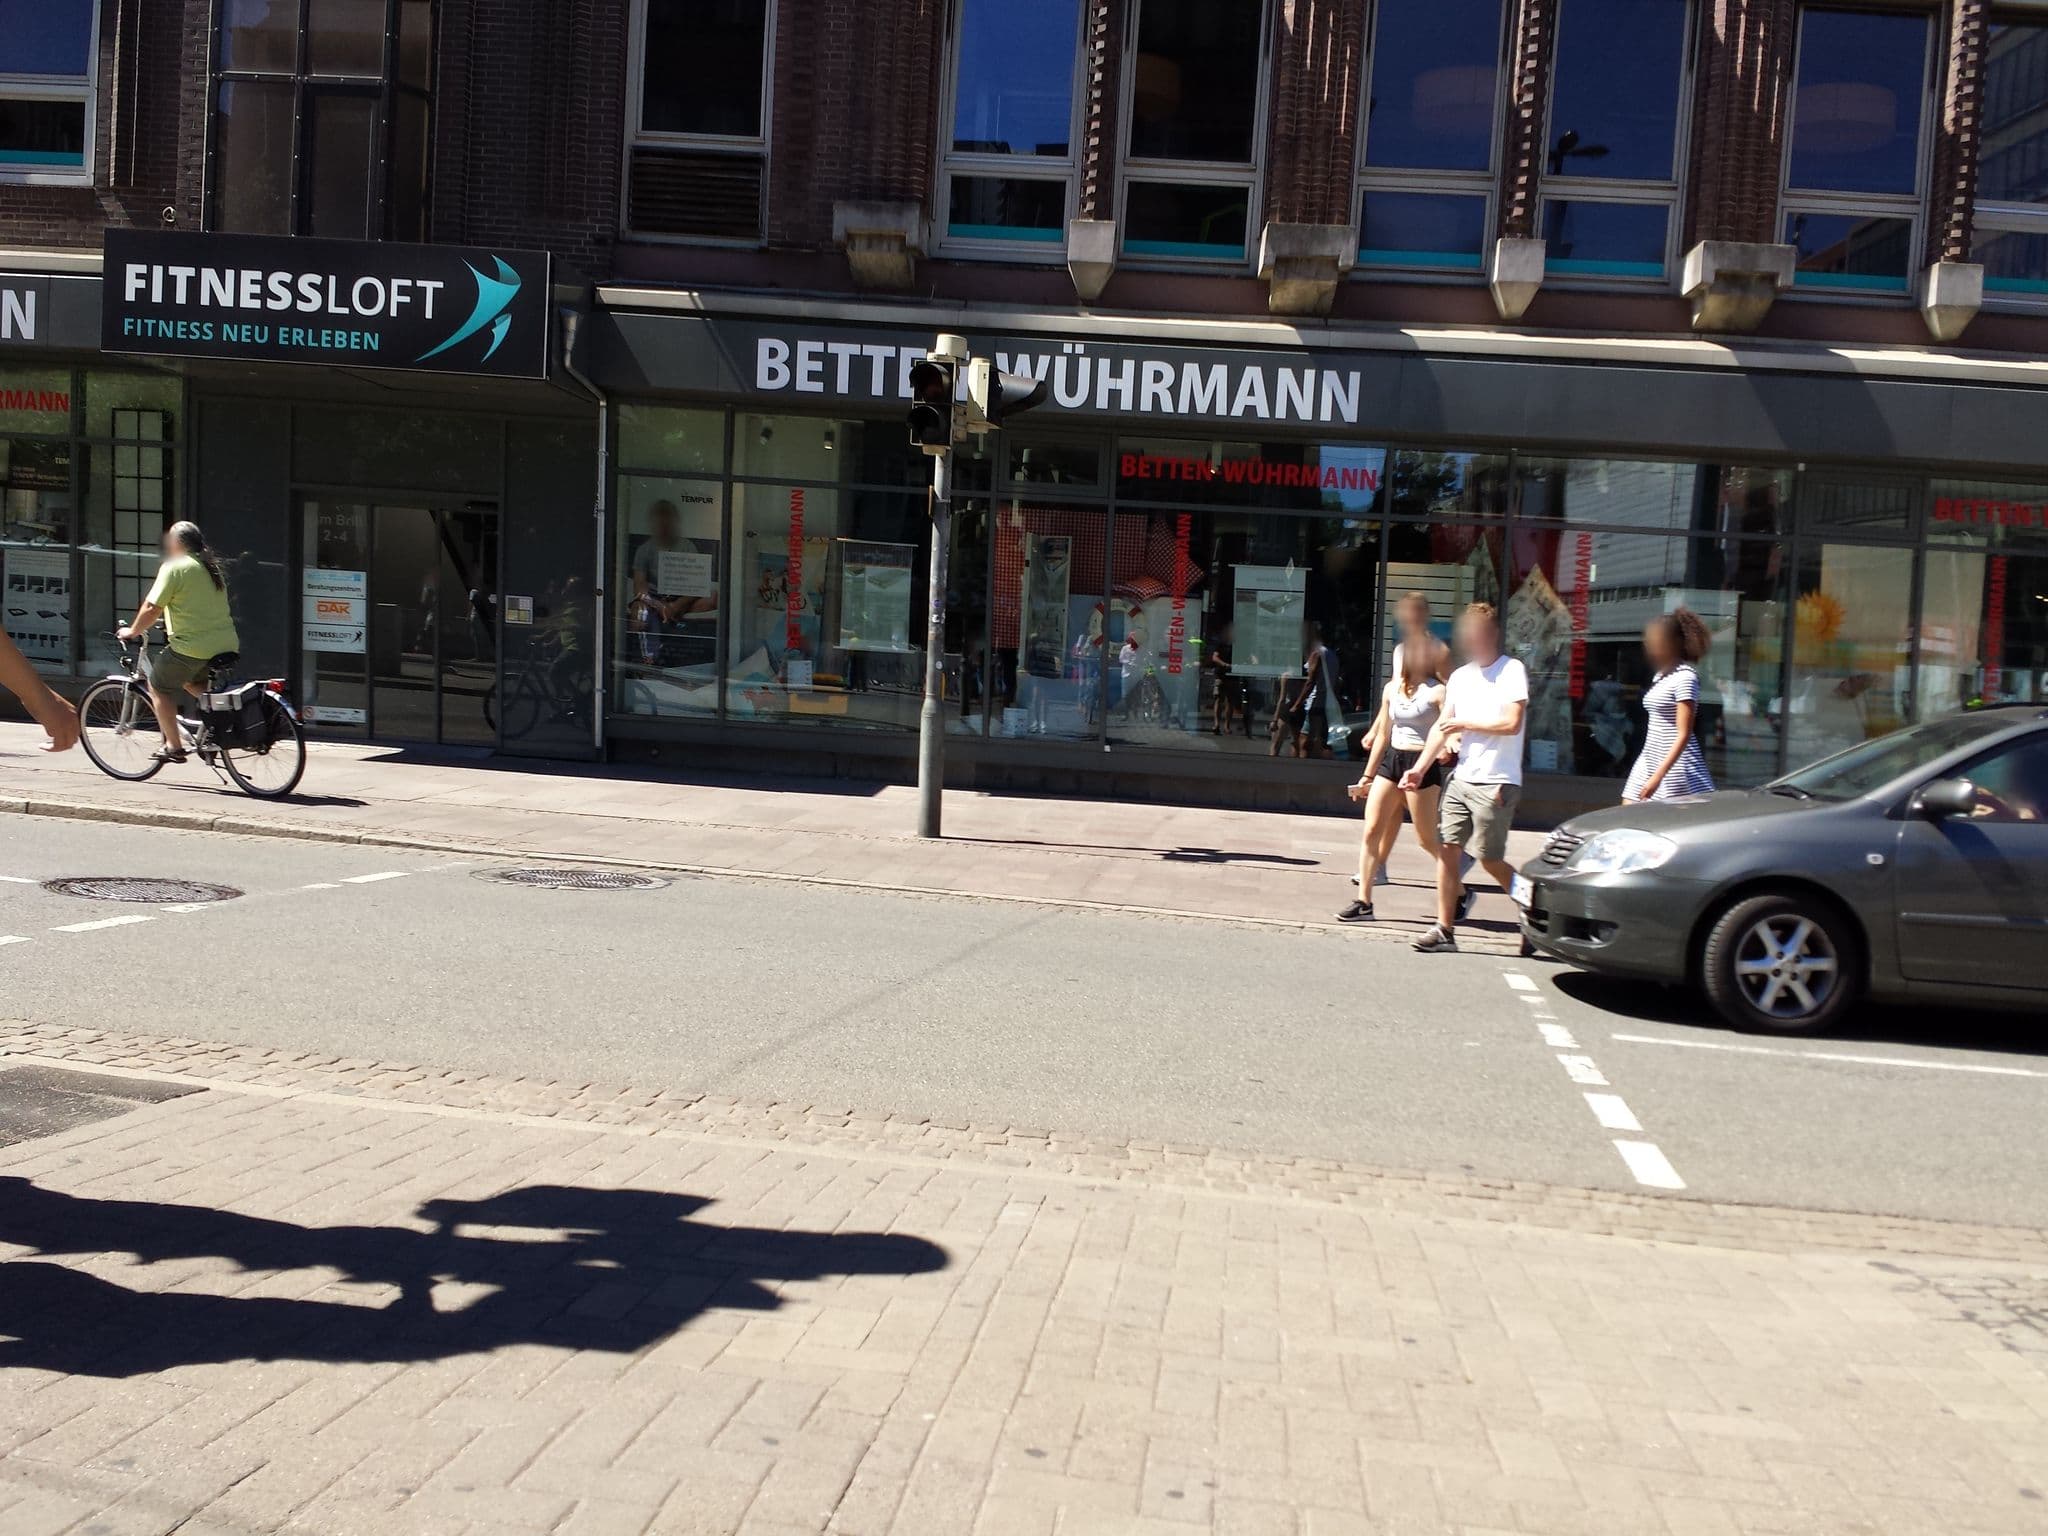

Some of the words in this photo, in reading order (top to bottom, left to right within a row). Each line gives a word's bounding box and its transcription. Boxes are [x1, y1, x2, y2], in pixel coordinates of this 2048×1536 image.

[125, 263, 444, 320] FITNESSLOFT
[123, 317, 214, 341] FITNESS
[222, 323, 269, 344] NEU
[278, 326, 380, 351] ERLEBEN
[681, 495, 714, 505] TEMPUR
[317, 602, 351, 614] DAK
[307, 630, 353, 640] FITNESSLOFT
